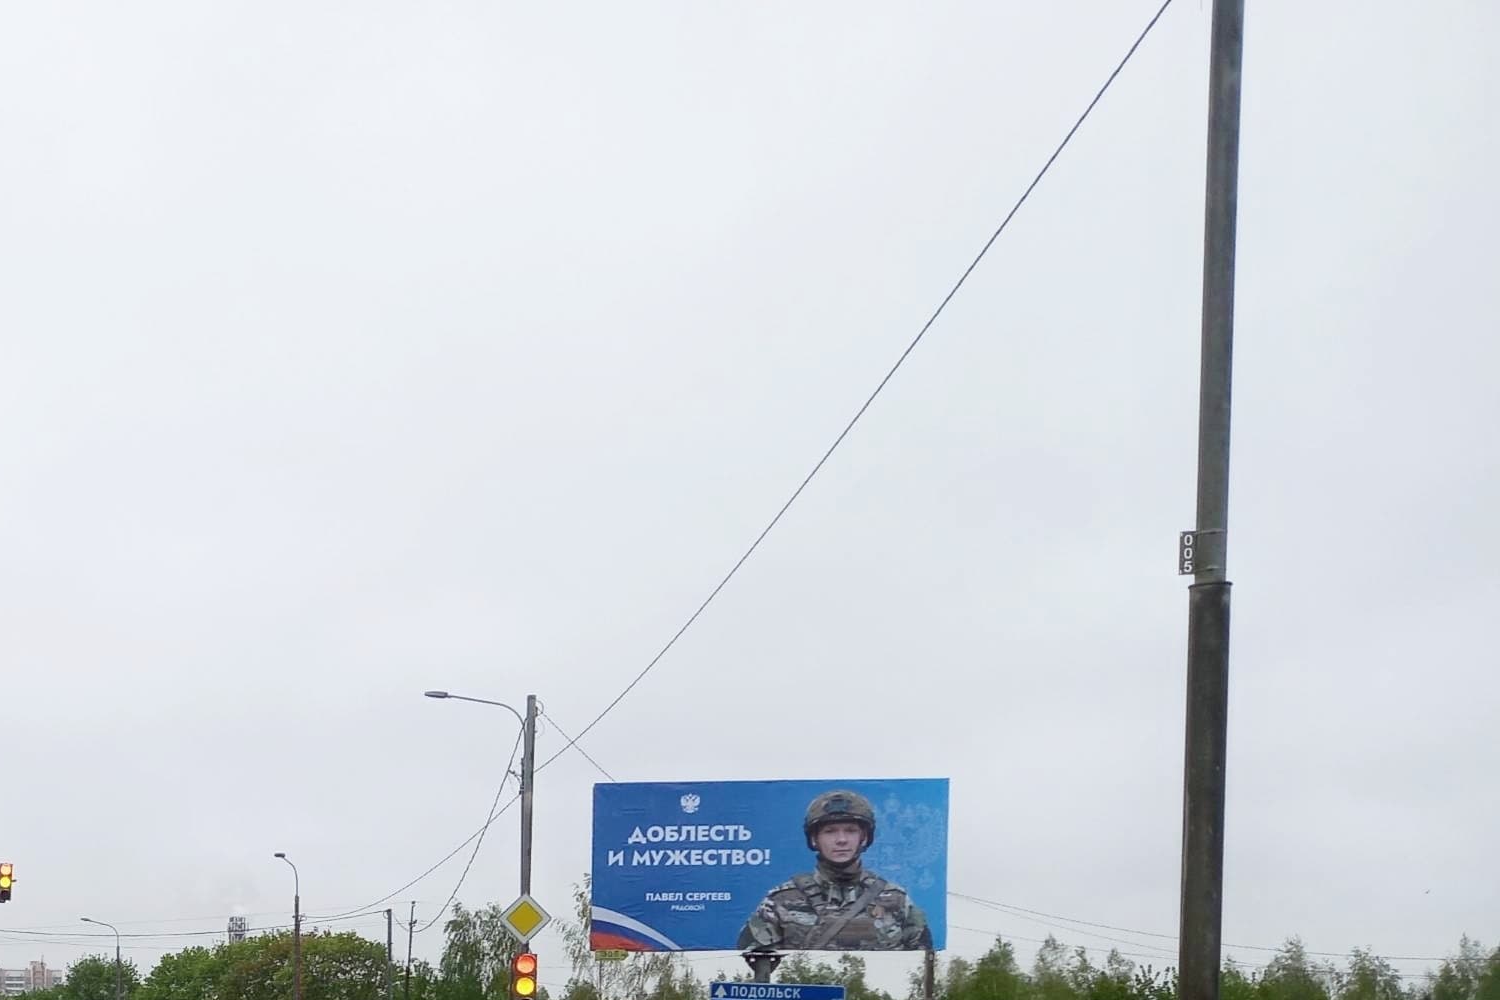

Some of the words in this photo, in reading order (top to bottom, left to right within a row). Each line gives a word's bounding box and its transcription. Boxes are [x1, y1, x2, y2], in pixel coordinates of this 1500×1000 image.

[1183, 534, 1193, 573] 005
[627, 824, 752, 844] ДОБЛЕСТЬ
[608, 850, 624, 866] И
[632, 848, 771, 866] МУЖЕСТВО!
[645, 892, 683, 902] ПАВЕЛ
[685, 892, 731, 901] СЕРГЕЕВ
[730, 985, 801, 999] ПОДОЛЬСК
